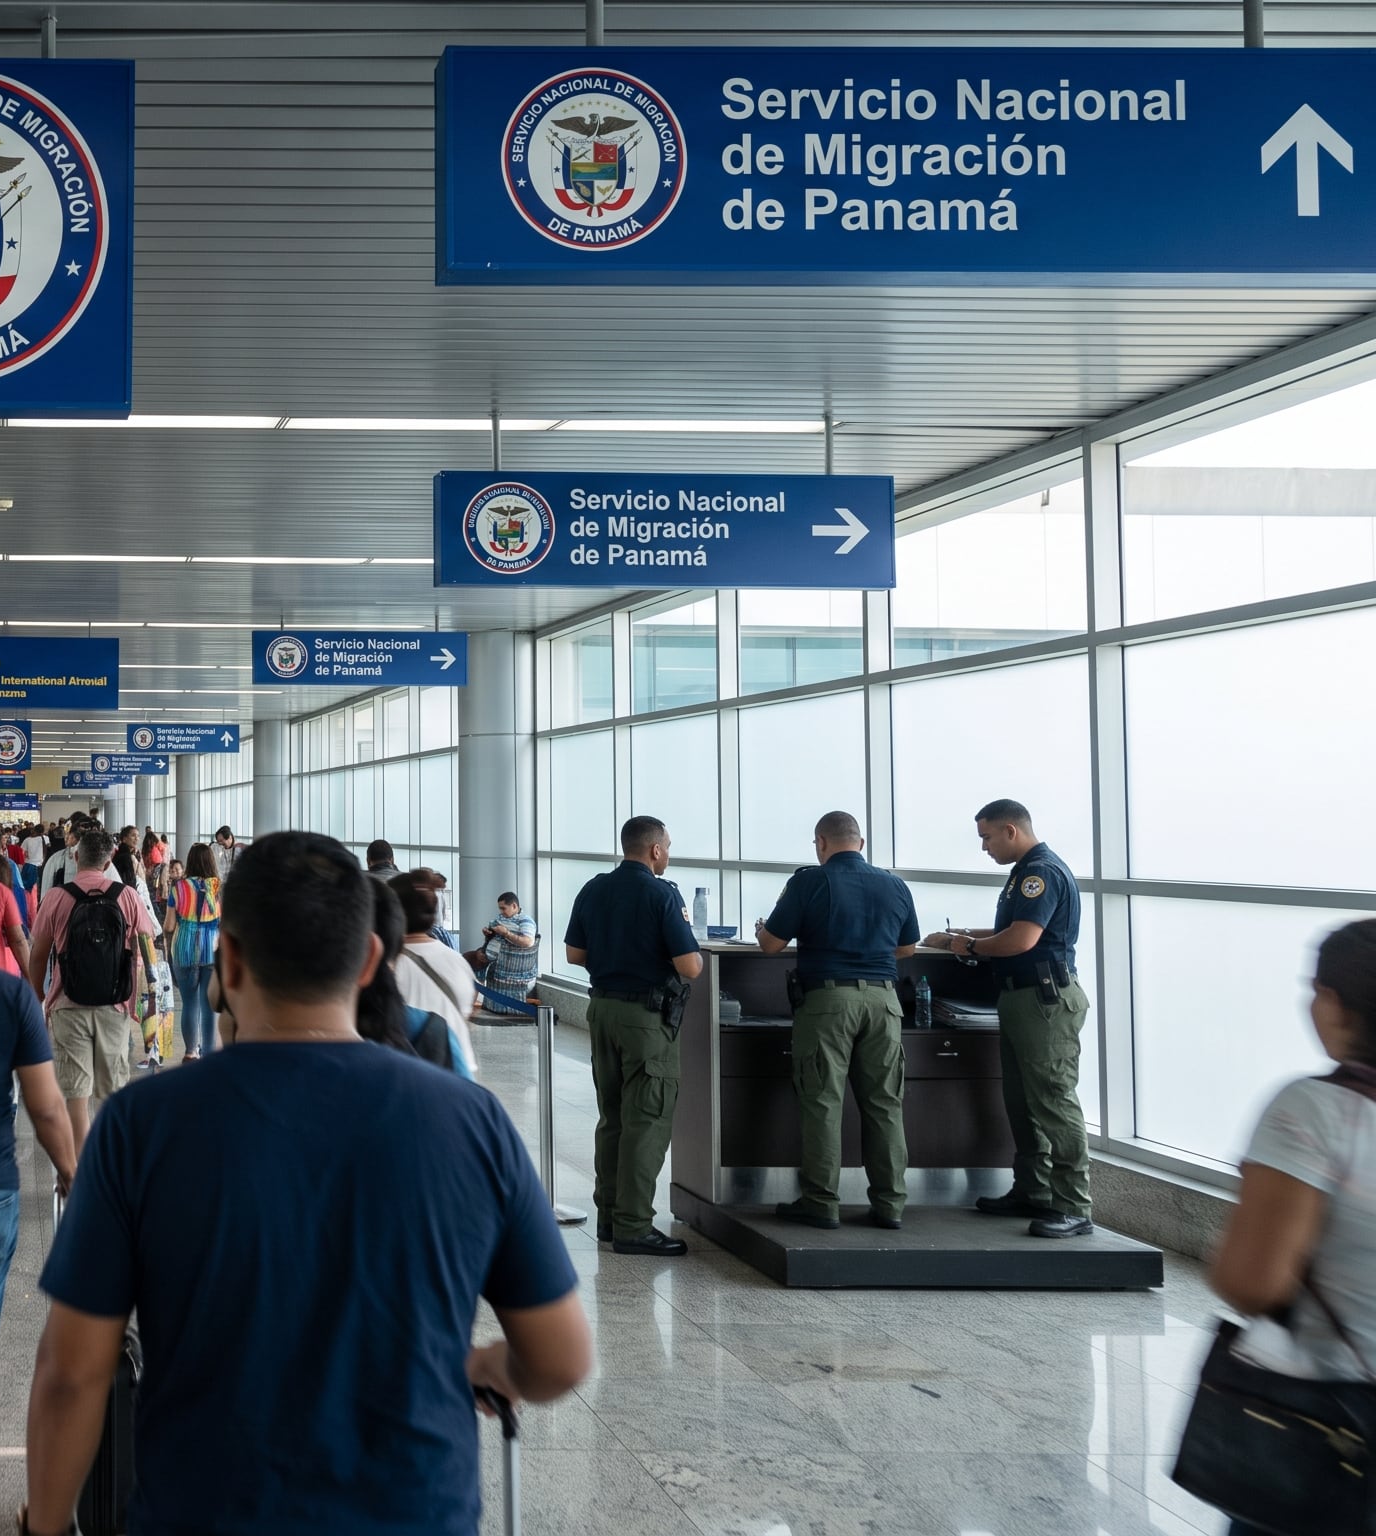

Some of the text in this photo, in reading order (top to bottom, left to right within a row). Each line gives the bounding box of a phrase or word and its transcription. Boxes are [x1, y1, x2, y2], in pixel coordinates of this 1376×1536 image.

[722, 78, 1185, 120] Servicio Nacional
[512, 103, 542, 162] SERVICIO
[541, 78, 611, 105] NACIONAL
[614, 82, 635, 98] DE
[23, 110, 92, 234] MIGRACIÓN
[722, 134, 1065, 186] de Migración
[723, 188, 1018, 231] de Panamá
[547, 216, 643, 242] DE PANAMÁ
[570, 489, 784, 512] Servicio Nacional
[570, 516, 729, 543] de Migración
[570, 544, 706, 566] de Panamá
[315, 639, 364, 649] Servicio
[368, 639, 420, 649] Nacional
[315, 652, 392, 664] de Migración
[315, 665, 382, 675] de Panamá
[1, 676, 66, 685] International
